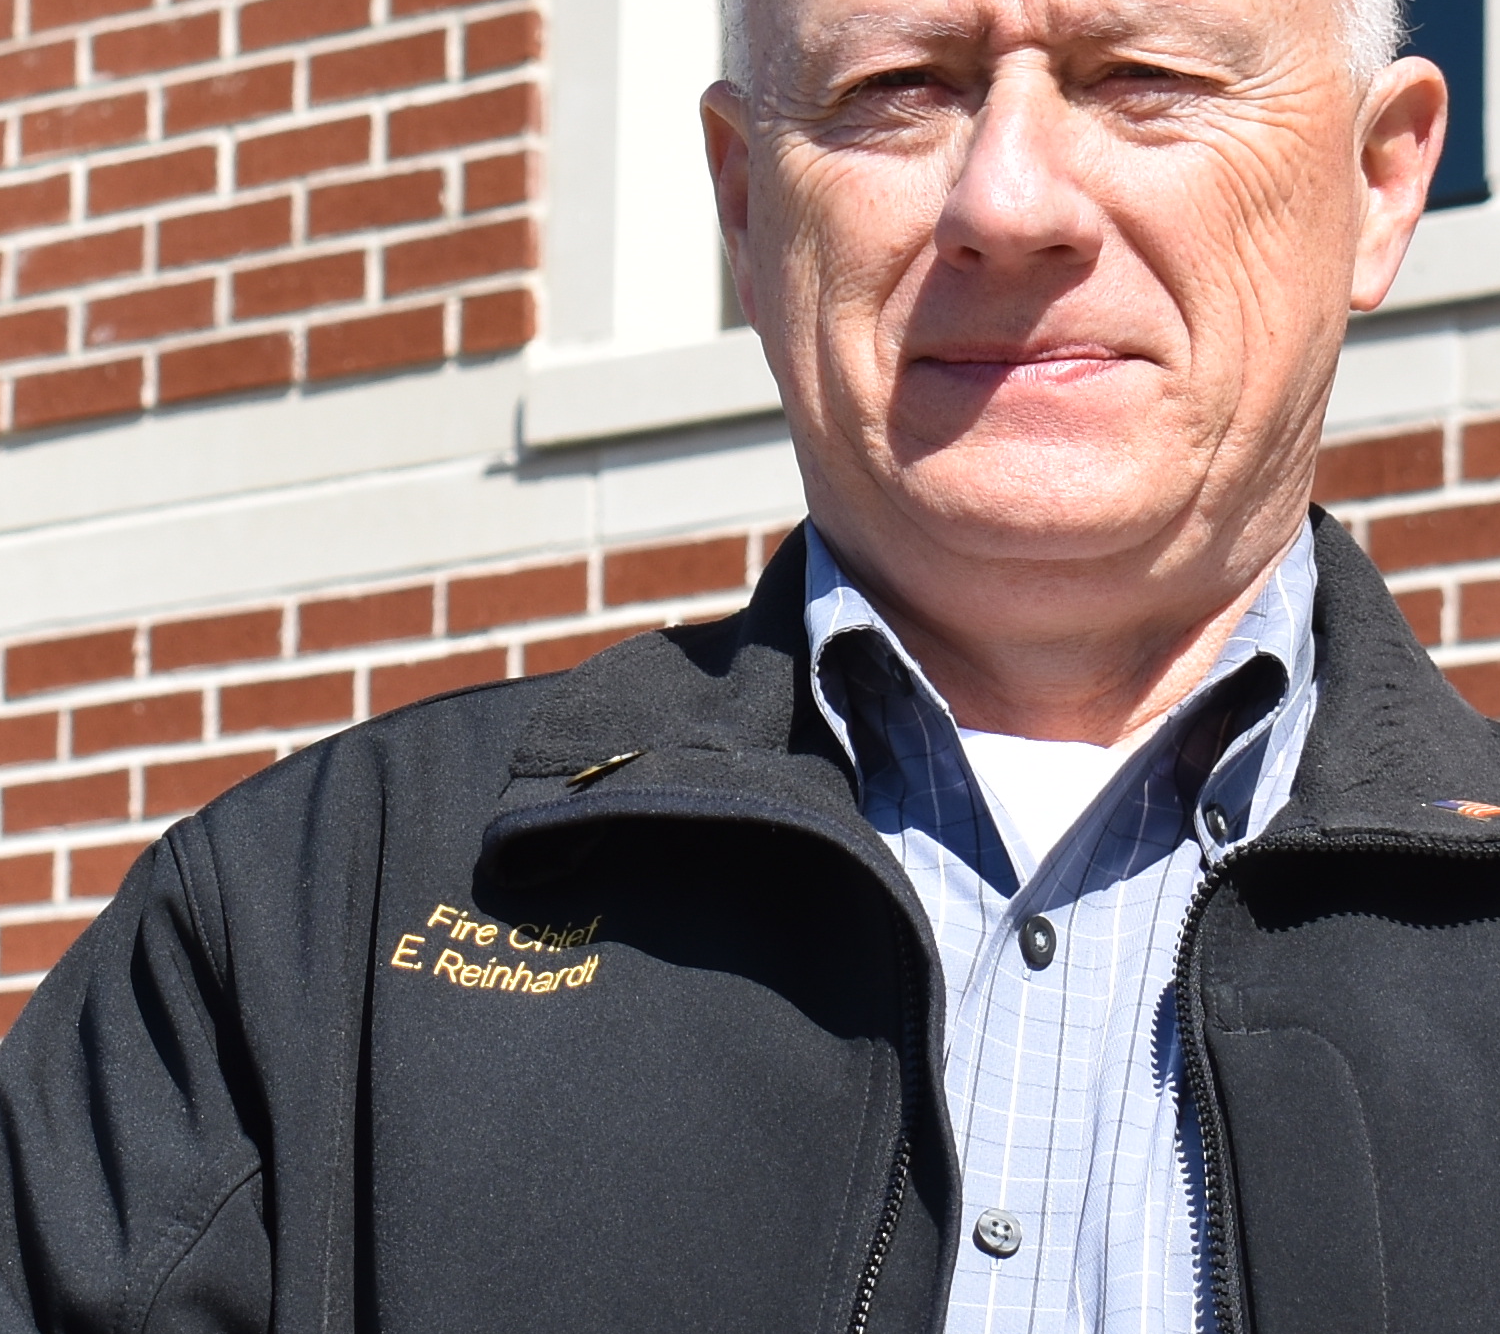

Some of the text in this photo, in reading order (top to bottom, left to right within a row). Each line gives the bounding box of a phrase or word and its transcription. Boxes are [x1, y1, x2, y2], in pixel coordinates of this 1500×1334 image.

[427, 904, 601, 952] Fire Chief
[434, 948, 599, 993] Reinhardt
